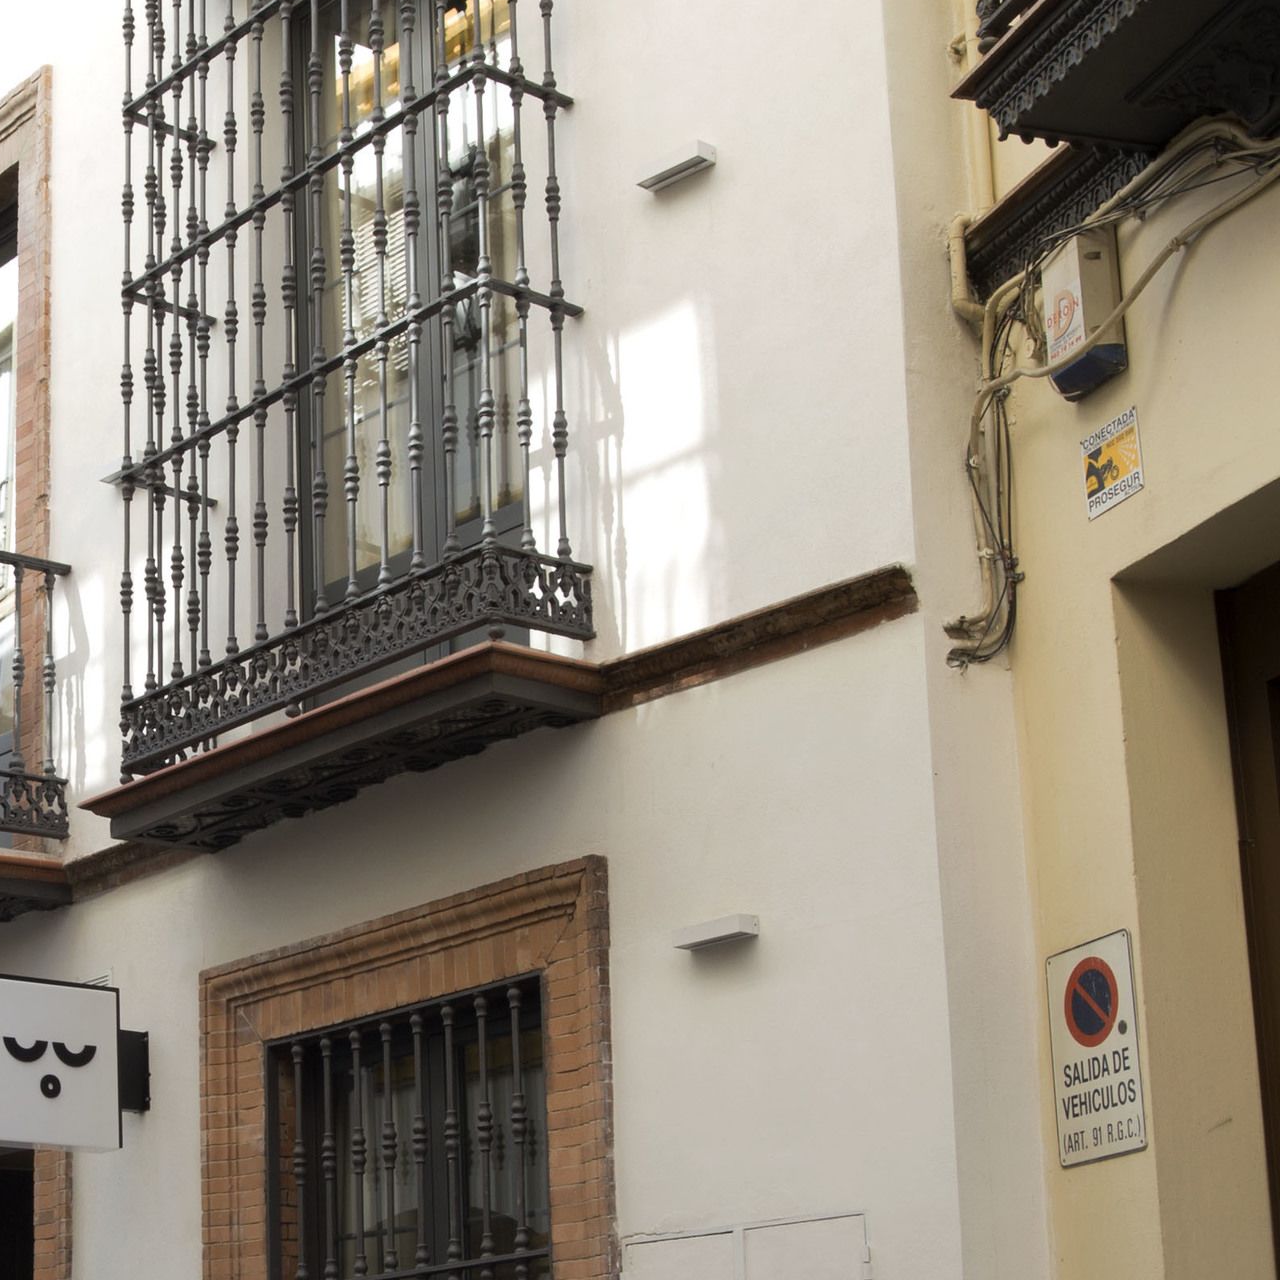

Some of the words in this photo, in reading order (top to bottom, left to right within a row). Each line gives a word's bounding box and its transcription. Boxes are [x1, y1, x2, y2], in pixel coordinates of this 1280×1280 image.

[1082, 409, 1135, 450] CONECTADA
[1088, 471, 1141, 513] PROSEGUR
[1063, 1053, 1111, 1089] SALIDA
[1112, 1047, 1131, 1075] DE
[1062, 1078, 1137, 1121] VEHICULOS
[1062, 1130, 1089, 1156] (ART.
[1092, 1125, 1103, 1148] 91
[1107, 1113, 1141, 1144] R.G.C.)
